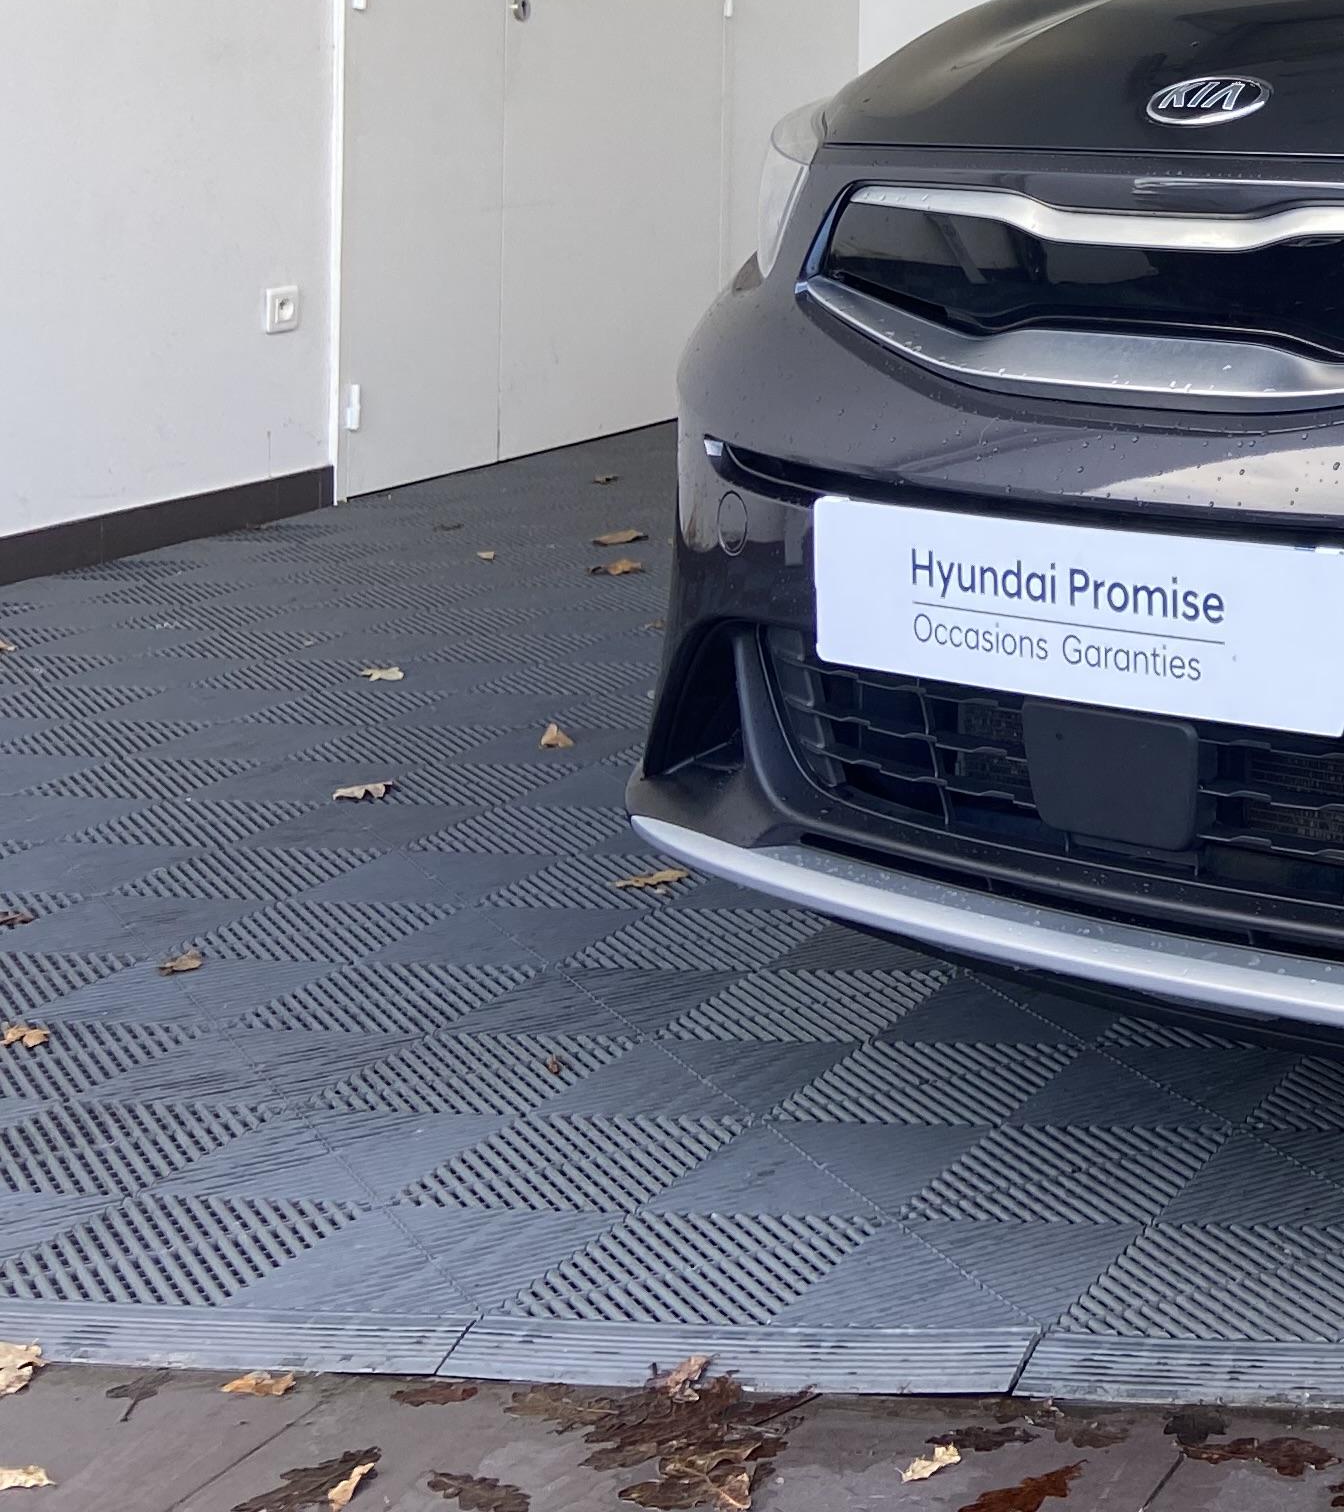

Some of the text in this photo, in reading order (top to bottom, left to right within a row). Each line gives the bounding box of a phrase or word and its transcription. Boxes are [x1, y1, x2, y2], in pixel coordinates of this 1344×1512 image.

[1158, 81, 1246, 111] KIA
[911, 547, 1225, 625] Hyundai Promise
[912, 612, 1202, 682] Occasions Garanties
